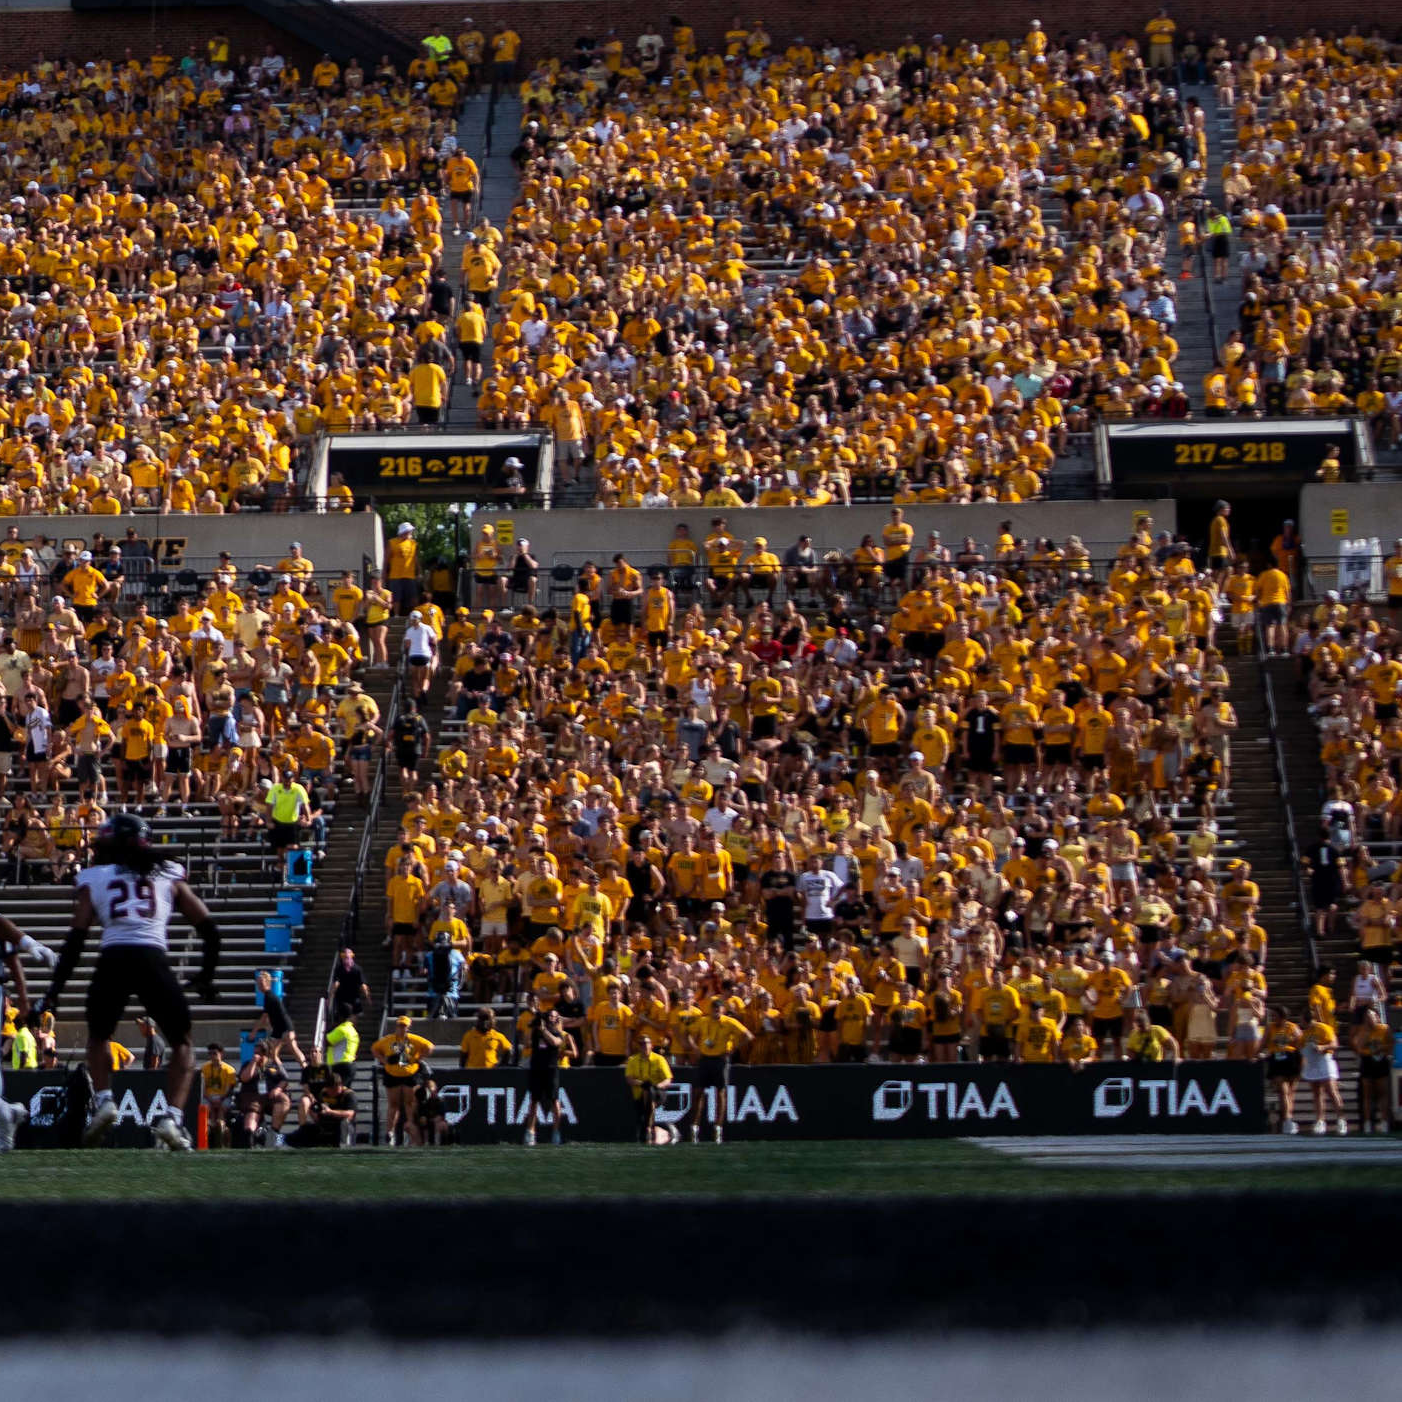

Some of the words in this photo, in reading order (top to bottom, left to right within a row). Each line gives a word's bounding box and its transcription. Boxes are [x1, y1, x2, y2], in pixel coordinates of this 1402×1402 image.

[379, 456, 423, 477] 216
[447, 455, 490, 476] 217
[1175, 443, 1217, 464] 217
[1242, 442, 1286, 462] 218
[106, 878, 156, 919] 29
[917, 1080, 1020, 1120] TIAA
[1138, 1078, 1241, 1116] TIAA
